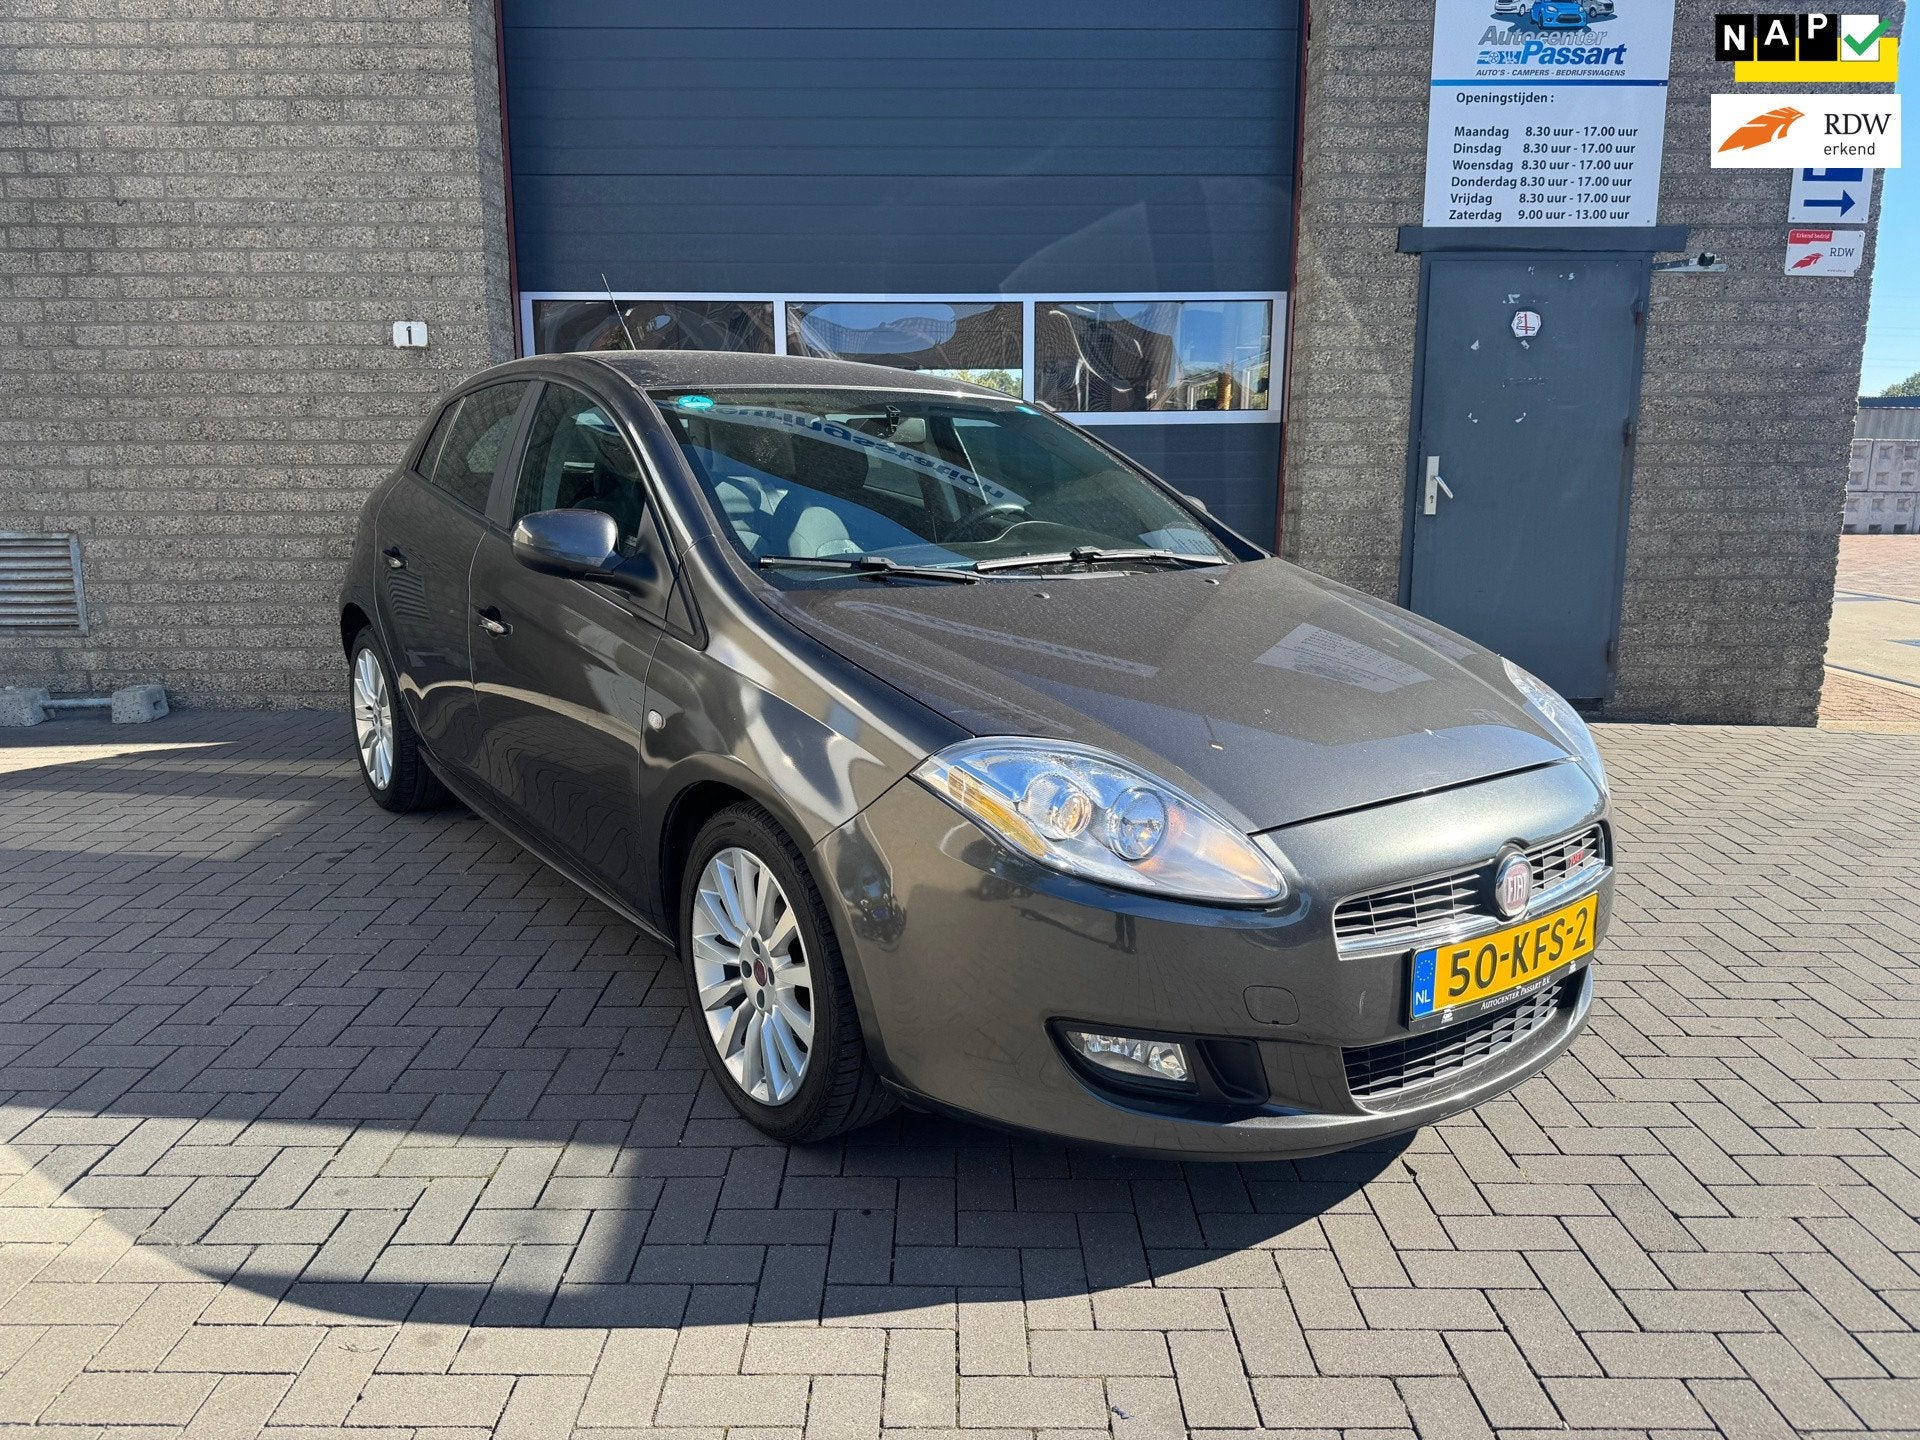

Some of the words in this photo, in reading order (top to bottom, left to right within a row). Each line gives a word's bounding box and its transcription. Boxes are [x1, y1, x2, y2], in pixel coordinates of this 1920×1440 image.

[1478, 26, 1607, 45] Autocenter
[1520, 40, 1627, 65] Passart
[1555, 69, 1626, 77] BEDRIJFSWAGENS
[1456, 91, 1547, 105] Openingstijden
[1454, 126, 1509, 139] Maandag
[1525, 126, 1550, 137] 8.30
[1553, 128, 1573, 137] uur
[1584, 126, 1615, 137] 17.00
[1618, 128, 1638, 137] uur
[1453, 142, 1501, 156] Dinsdag
[1523, 143, 1548, 153] 8.30
[1551, 145, 1571, 153] uur
[1581, 143, 1612, 153] 17.00
[1615, 145, 1636, 153] uur
[1452, 159, 1513, 173] Woensdag
[1521, 160, 1546, 170] 8.30
[1549, 162, 1569, 170] uur
[1580, 160, 1611, 170] 17.00
[1614, 162, 1634, 170] uur
[1451, 176, 1517, 189] Donderdag
[1520, 176, 1545, 187] 8.30
[1548, 178, 1568, 187] uur
[1578, 176, 1609, 187] 17.00
[1612, 178, 1632, 187] uur
[1450, 192, 1492, 206] Vrijdag
[1519, 193, 1544, 203] 8.30
[1547, 195, 1567, 203] uur
[1577, 193, 1608, 203] 17.00
[1611, 195, 1631, 203] uur
[1449, 209, 1502, 222] Zaterdag
[1518, 209, 1543, 220] 9.00
[1546, 211, 1566, 220] uur
[1576, 209, 1607, 220] 13.00
[1610, 211, 1630, 220] uur
[1829, 247, 1855, 257] RDW
[405, 325, 412, 345] 1
[1506, 873, 1528, 903] FIAT
[1448, 906, 1588, 997] 50-KFS-2
[1415, 989, 1431, 1006] NL
